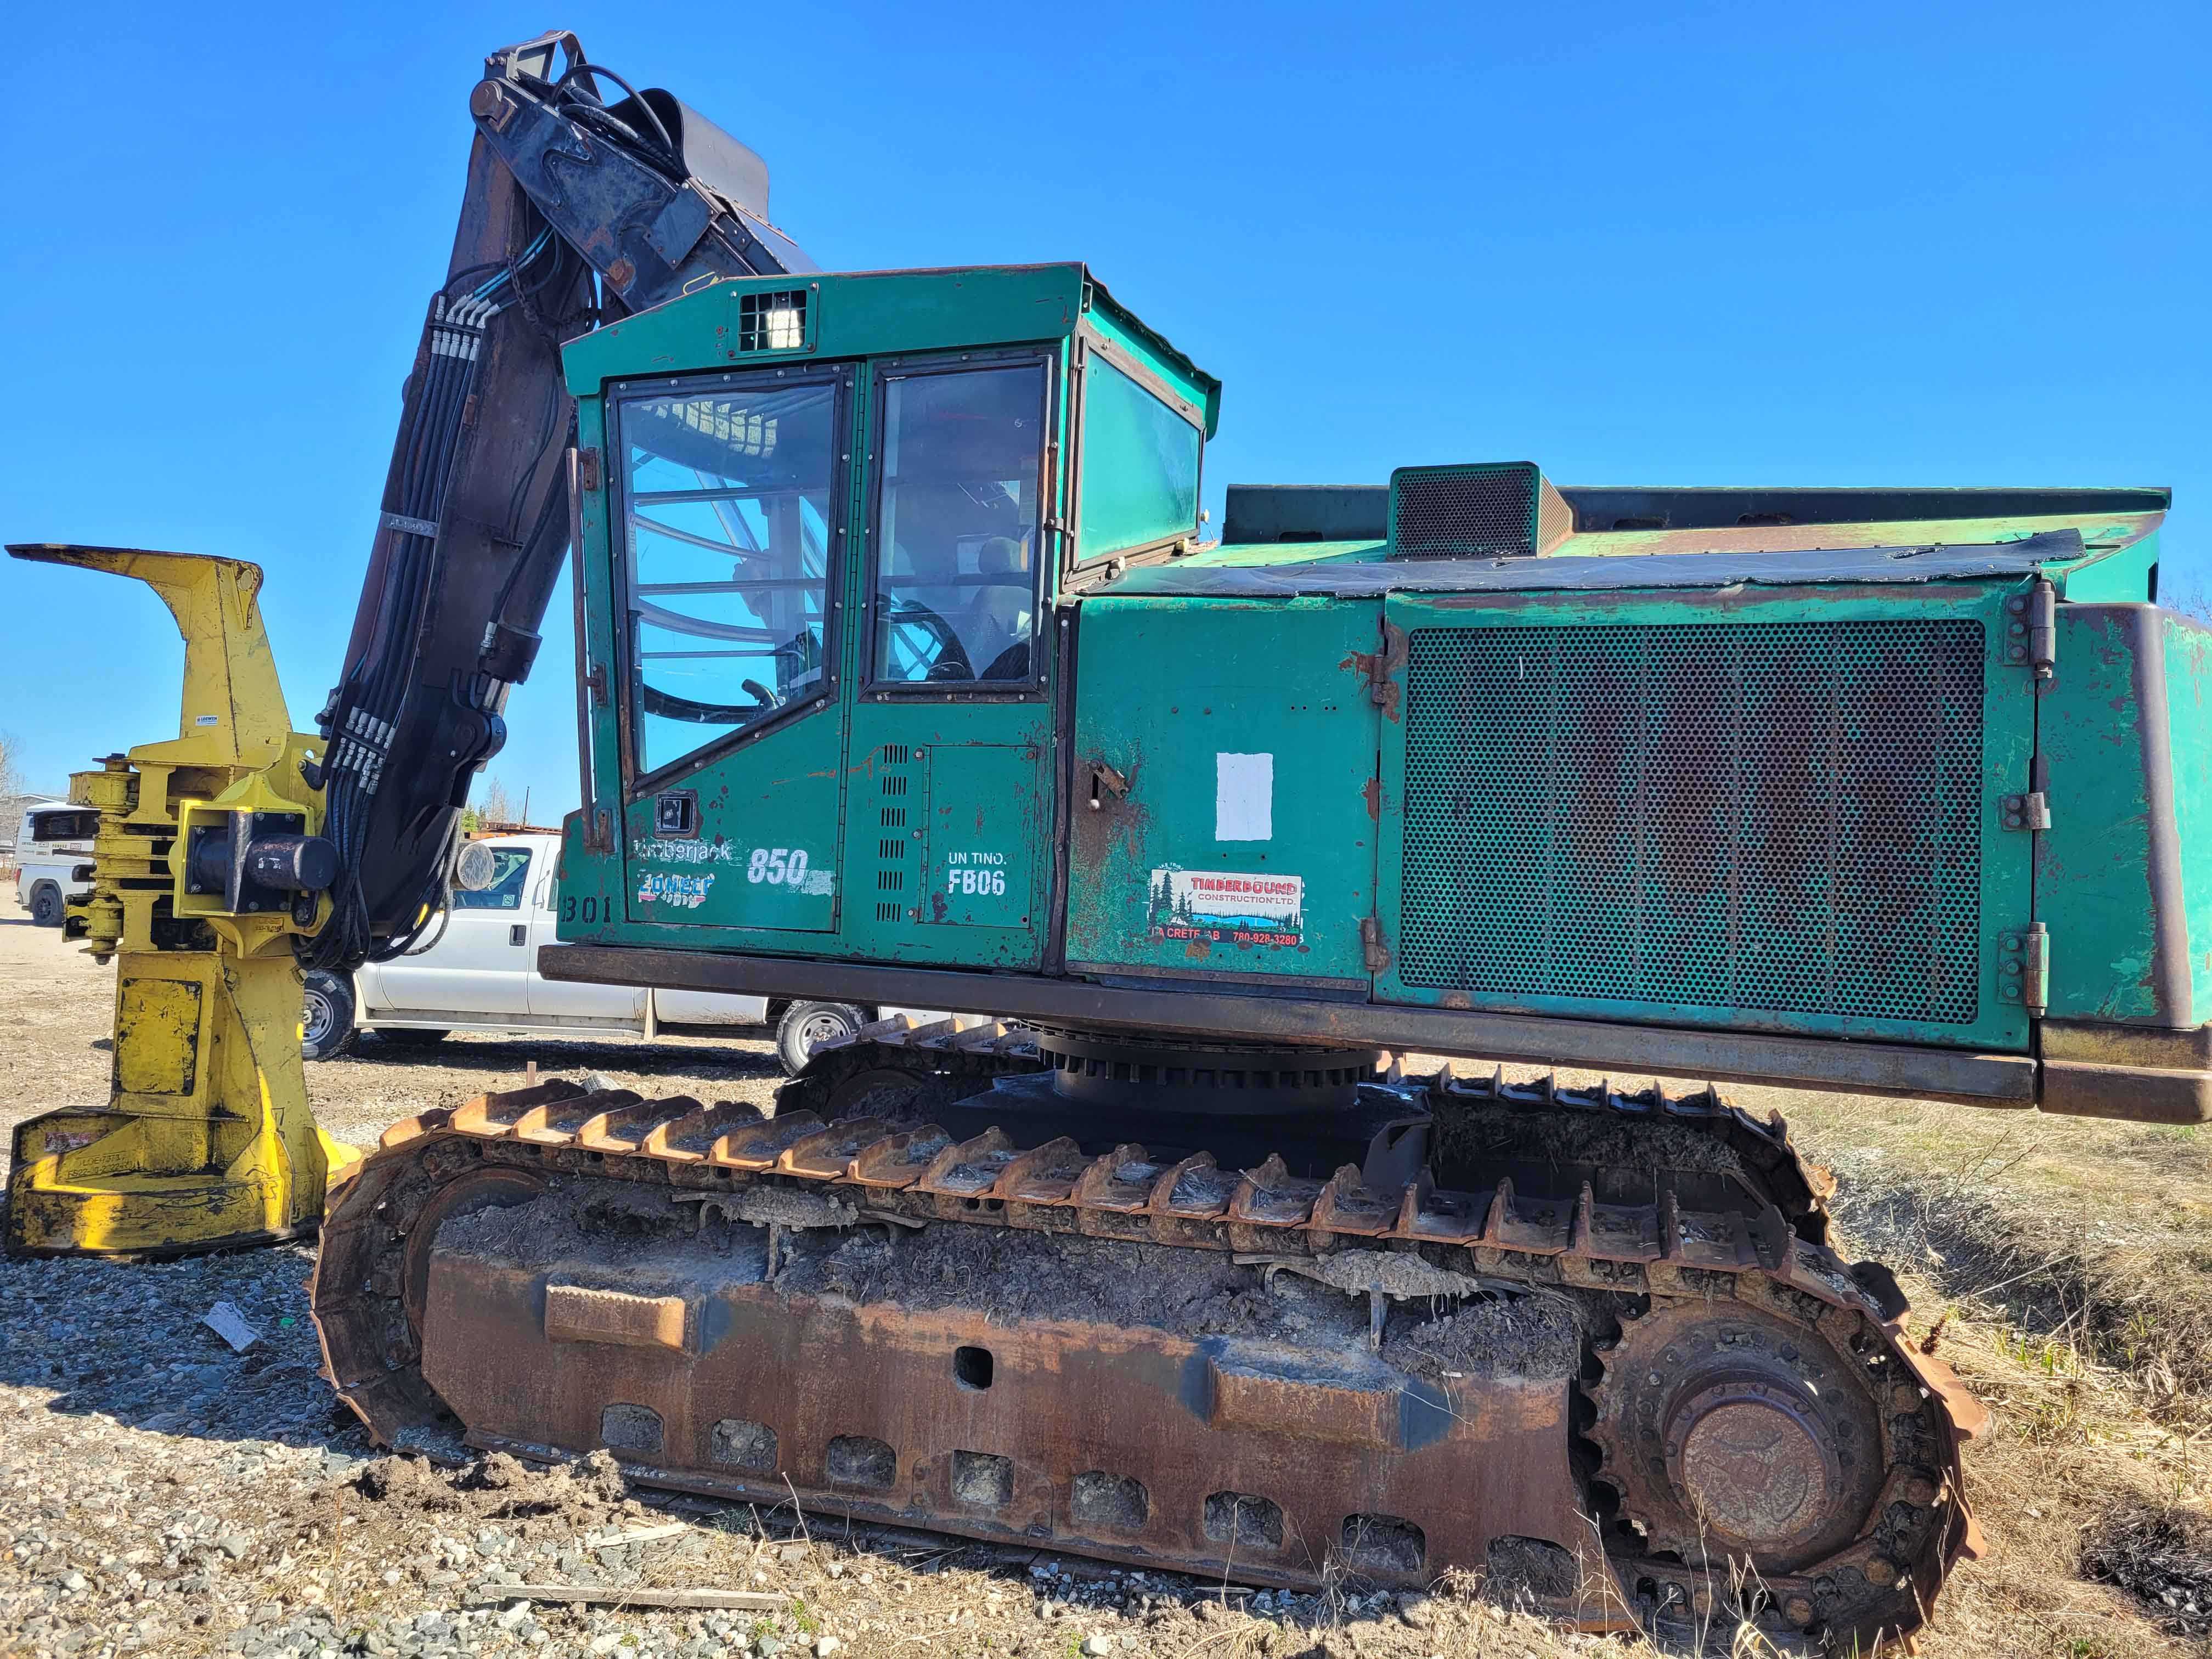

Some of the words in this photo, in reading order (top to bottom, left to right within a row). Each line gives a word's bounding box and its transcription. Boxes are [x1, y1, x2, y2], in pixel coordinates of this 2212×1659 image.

[747, 848, 808, 884] 850
[949, 852, 967, 865] UN
[948, 869, 1006, 896] FB06
[1192, 877, 1297, 896] TIMBERBOUND
[1198, 893, 1274, 904] CONSTRUCTION
[1276, 898, 1296, 906] LTD.
[1167, 927, 1200, 939] CRETE
[1233, 932, 1296, 945] 780-928-3280
